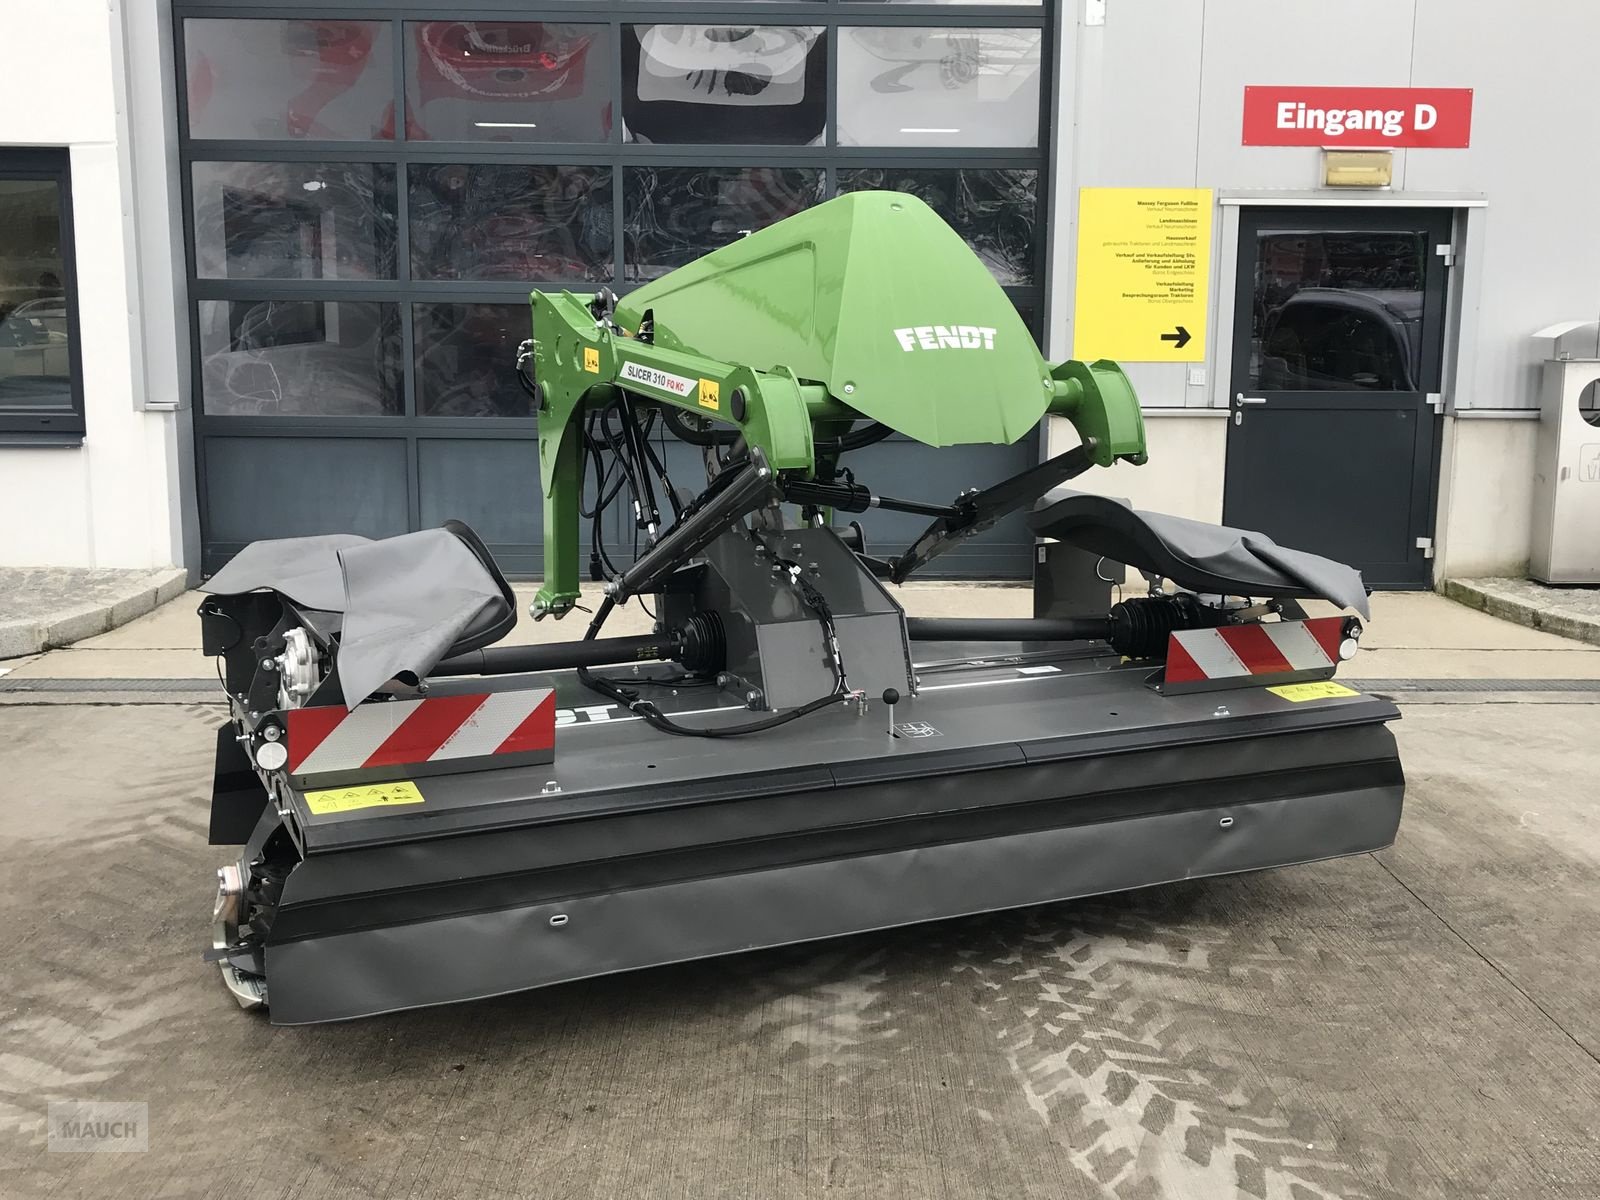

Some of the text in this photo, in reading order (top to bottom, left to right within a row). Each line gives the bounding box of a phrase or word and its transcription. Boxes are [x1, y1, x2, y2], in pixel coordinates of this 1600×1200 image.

[1276, 102, 1437, 136] Eingang D
[893, 325, 997, 352] FENDT
[627, 365, 685, 392] SLICER 310 FQ KC
